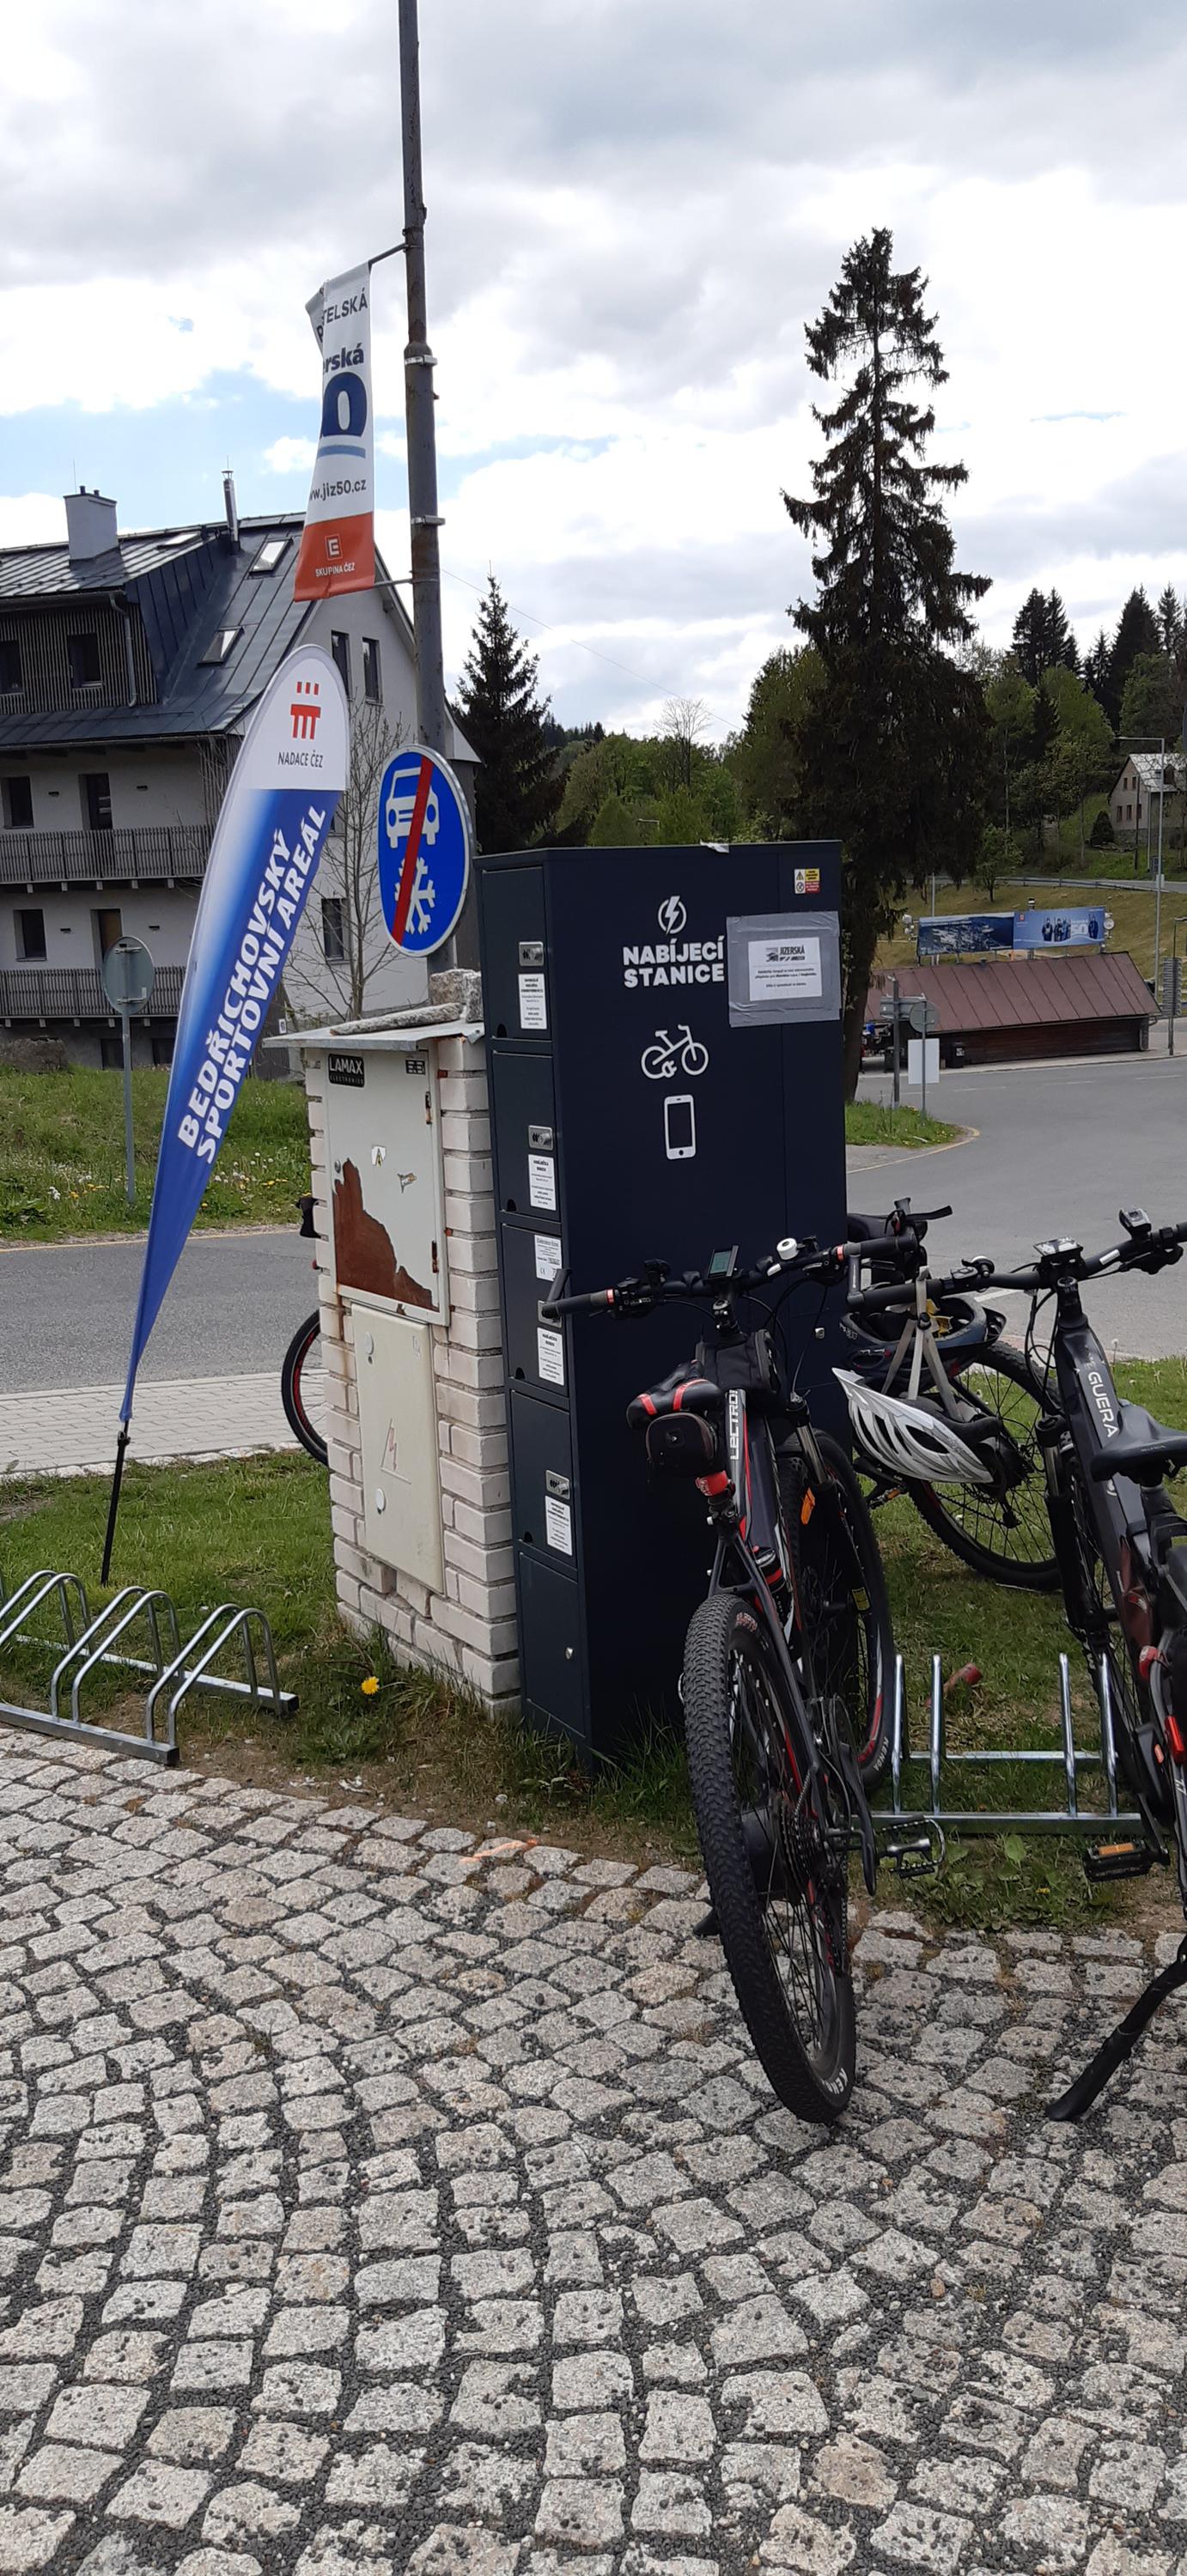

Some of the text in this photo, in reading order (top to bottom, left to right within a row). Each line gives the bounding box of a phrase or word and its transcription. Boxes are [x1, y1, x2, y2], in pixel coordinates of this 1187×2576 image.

[323, 343, 364, 374] rská
[320, 371, 368, 440] 0
[315, 562, 355, 578] SKUPINA ČEZ
[277, 750, 324, 768] NADACE ČEZ
[623, 935, 725, 965] NABÍJECÍ
[178, 828, 291, 1149] BEDŘICHOVSKÝ
[197, 805, 326, 1164] SPORTOVNÍ AREÁL
[624, 963, 725, 988] STANICE
[329, 1056, 363, 1074] LAMAX
[1087, 1371, 1118, 1438] GUERA
[873, 1735, 890, 1772] KENDA
